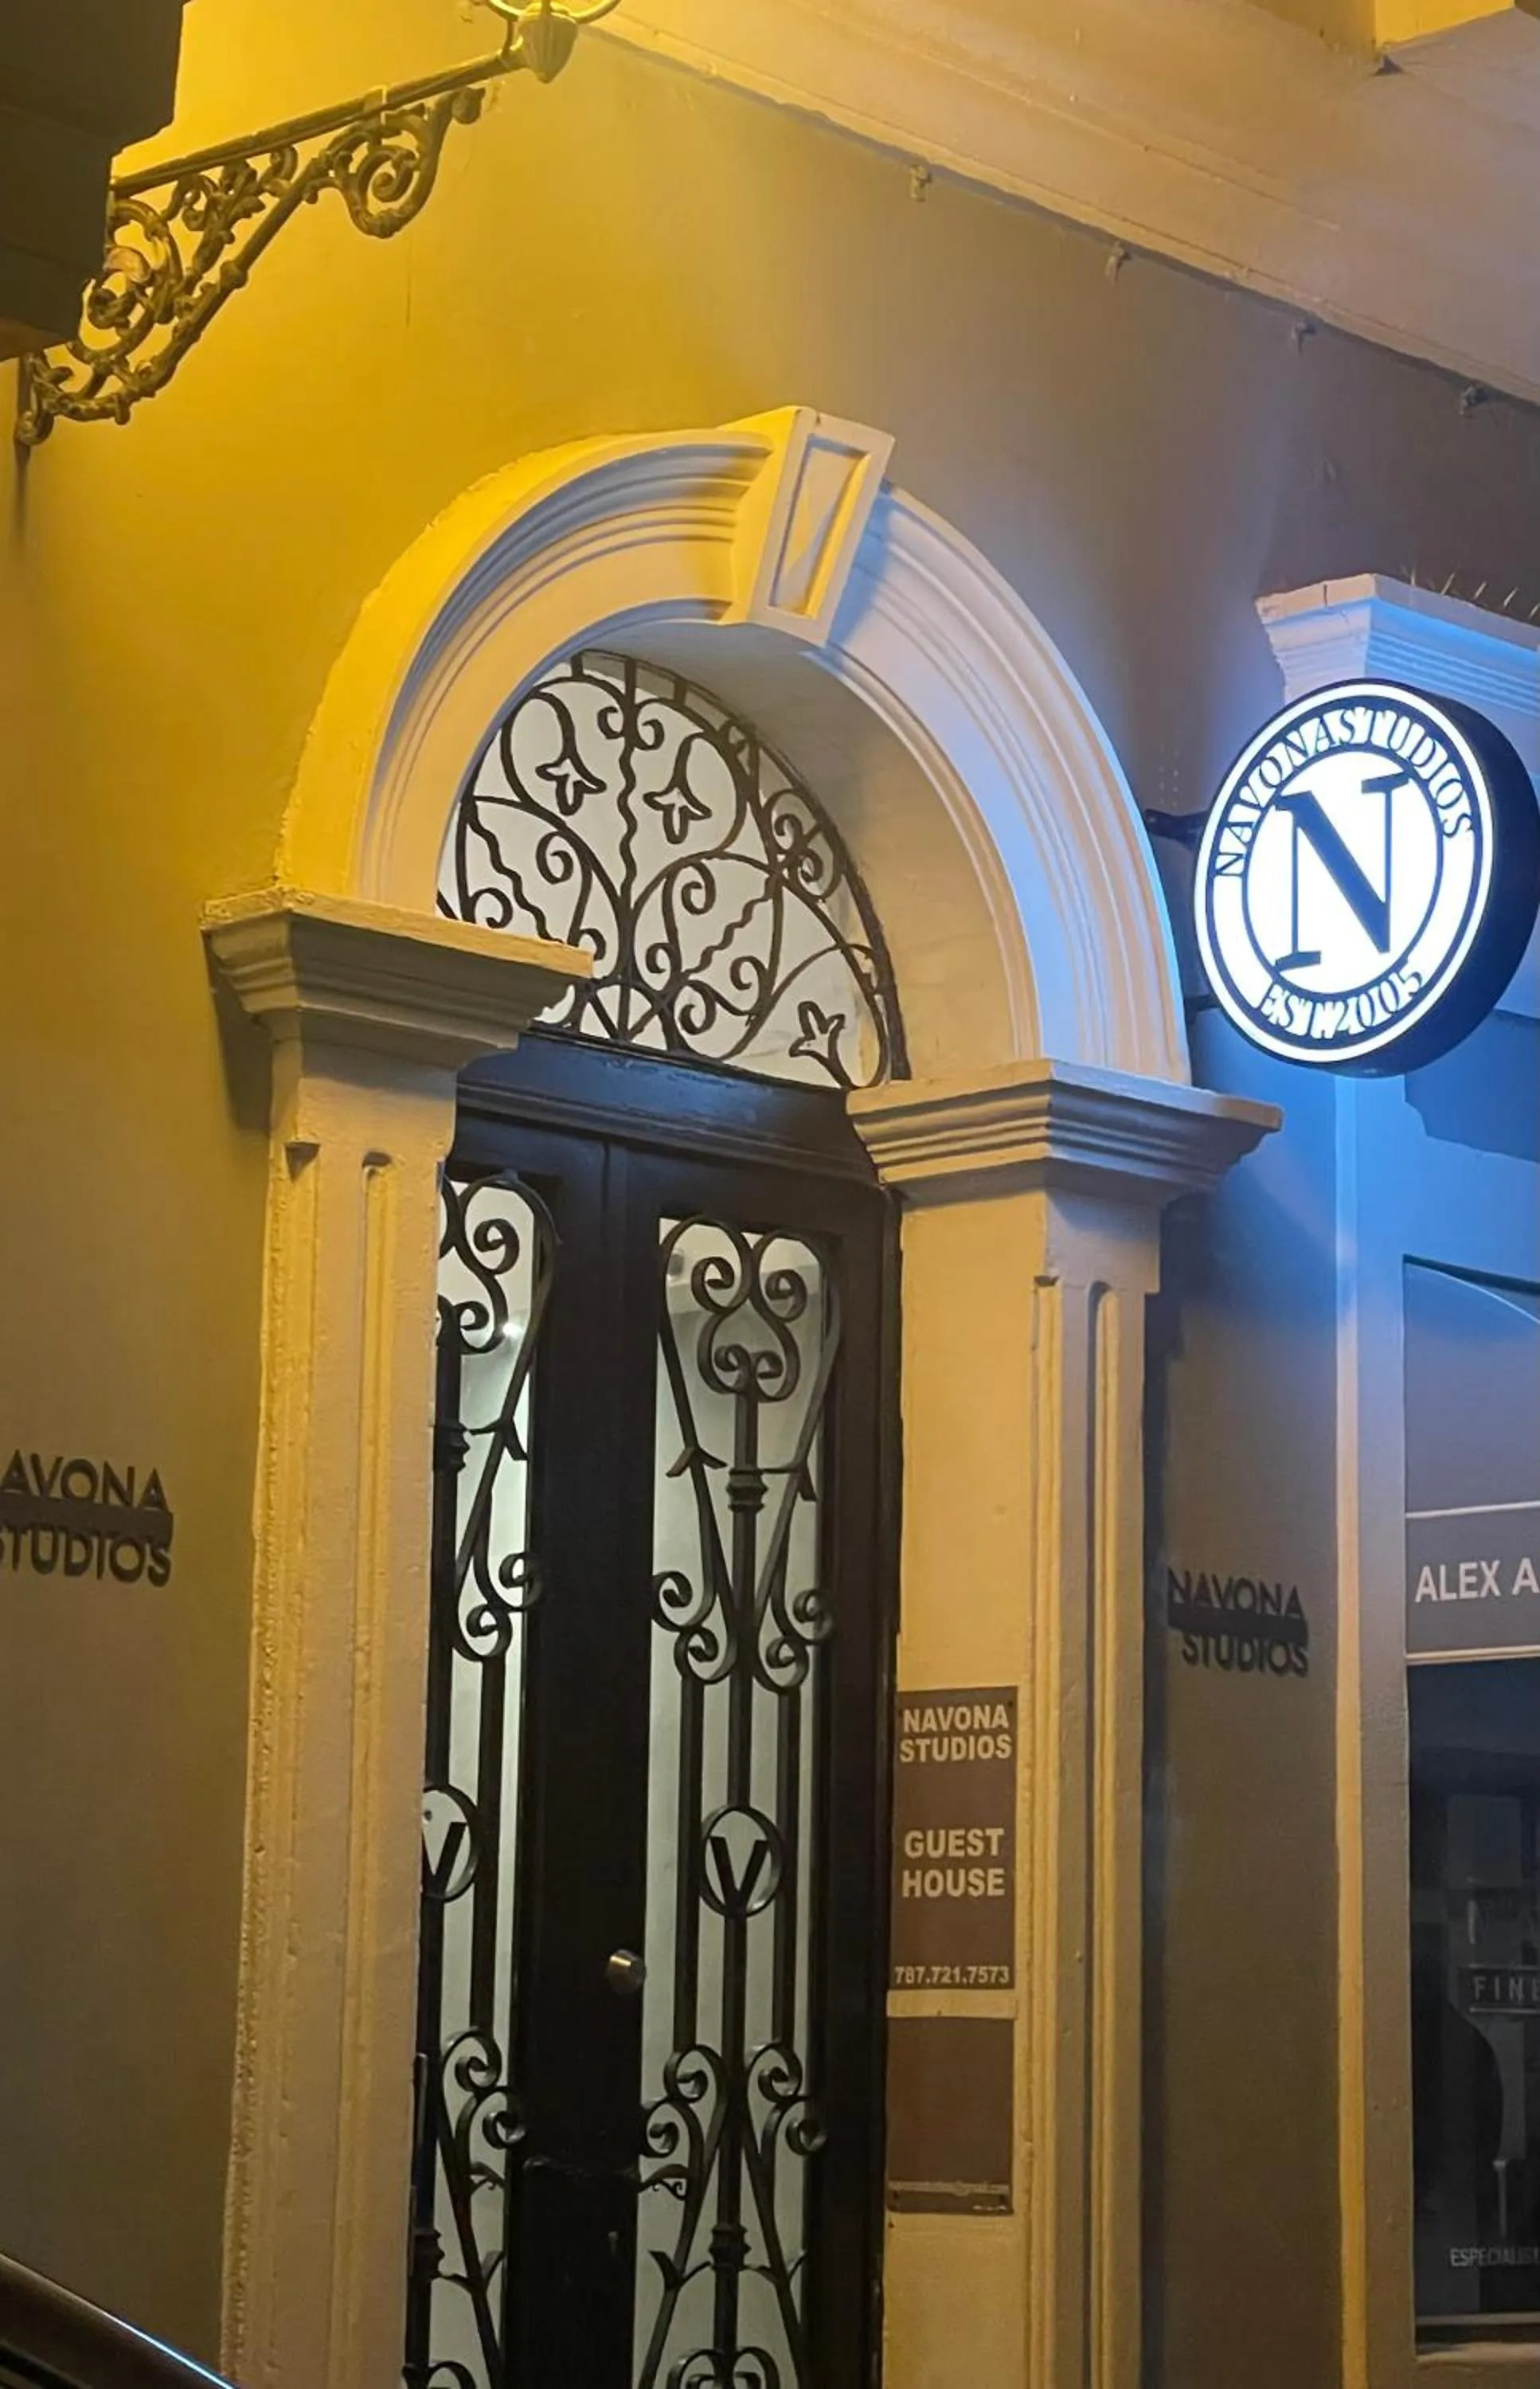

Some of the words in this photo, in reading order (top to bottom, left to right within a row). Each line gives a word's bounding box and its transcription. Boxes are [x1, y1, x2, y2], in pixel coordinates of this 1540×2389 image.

[1275, 769, 1412, 974] N
[0, 1523, 172, 1588] TUDIOS
[1167, 1567, 1305, 1620] NAVONA
[1414, 1560, 1501, 1603] ALEX
[1182, 1632, 1308, 1678] STUDIOS
[902, 1703, 1009, 1734] NAVONA
[899, 1734, 1013, 1763] STUDIOS
[904, 1828, 1005, 1859] GUEST
[901, 1867, 1006, 1898] HOUSE
[894, 1965, 1010, 1984] 787.721.7573
